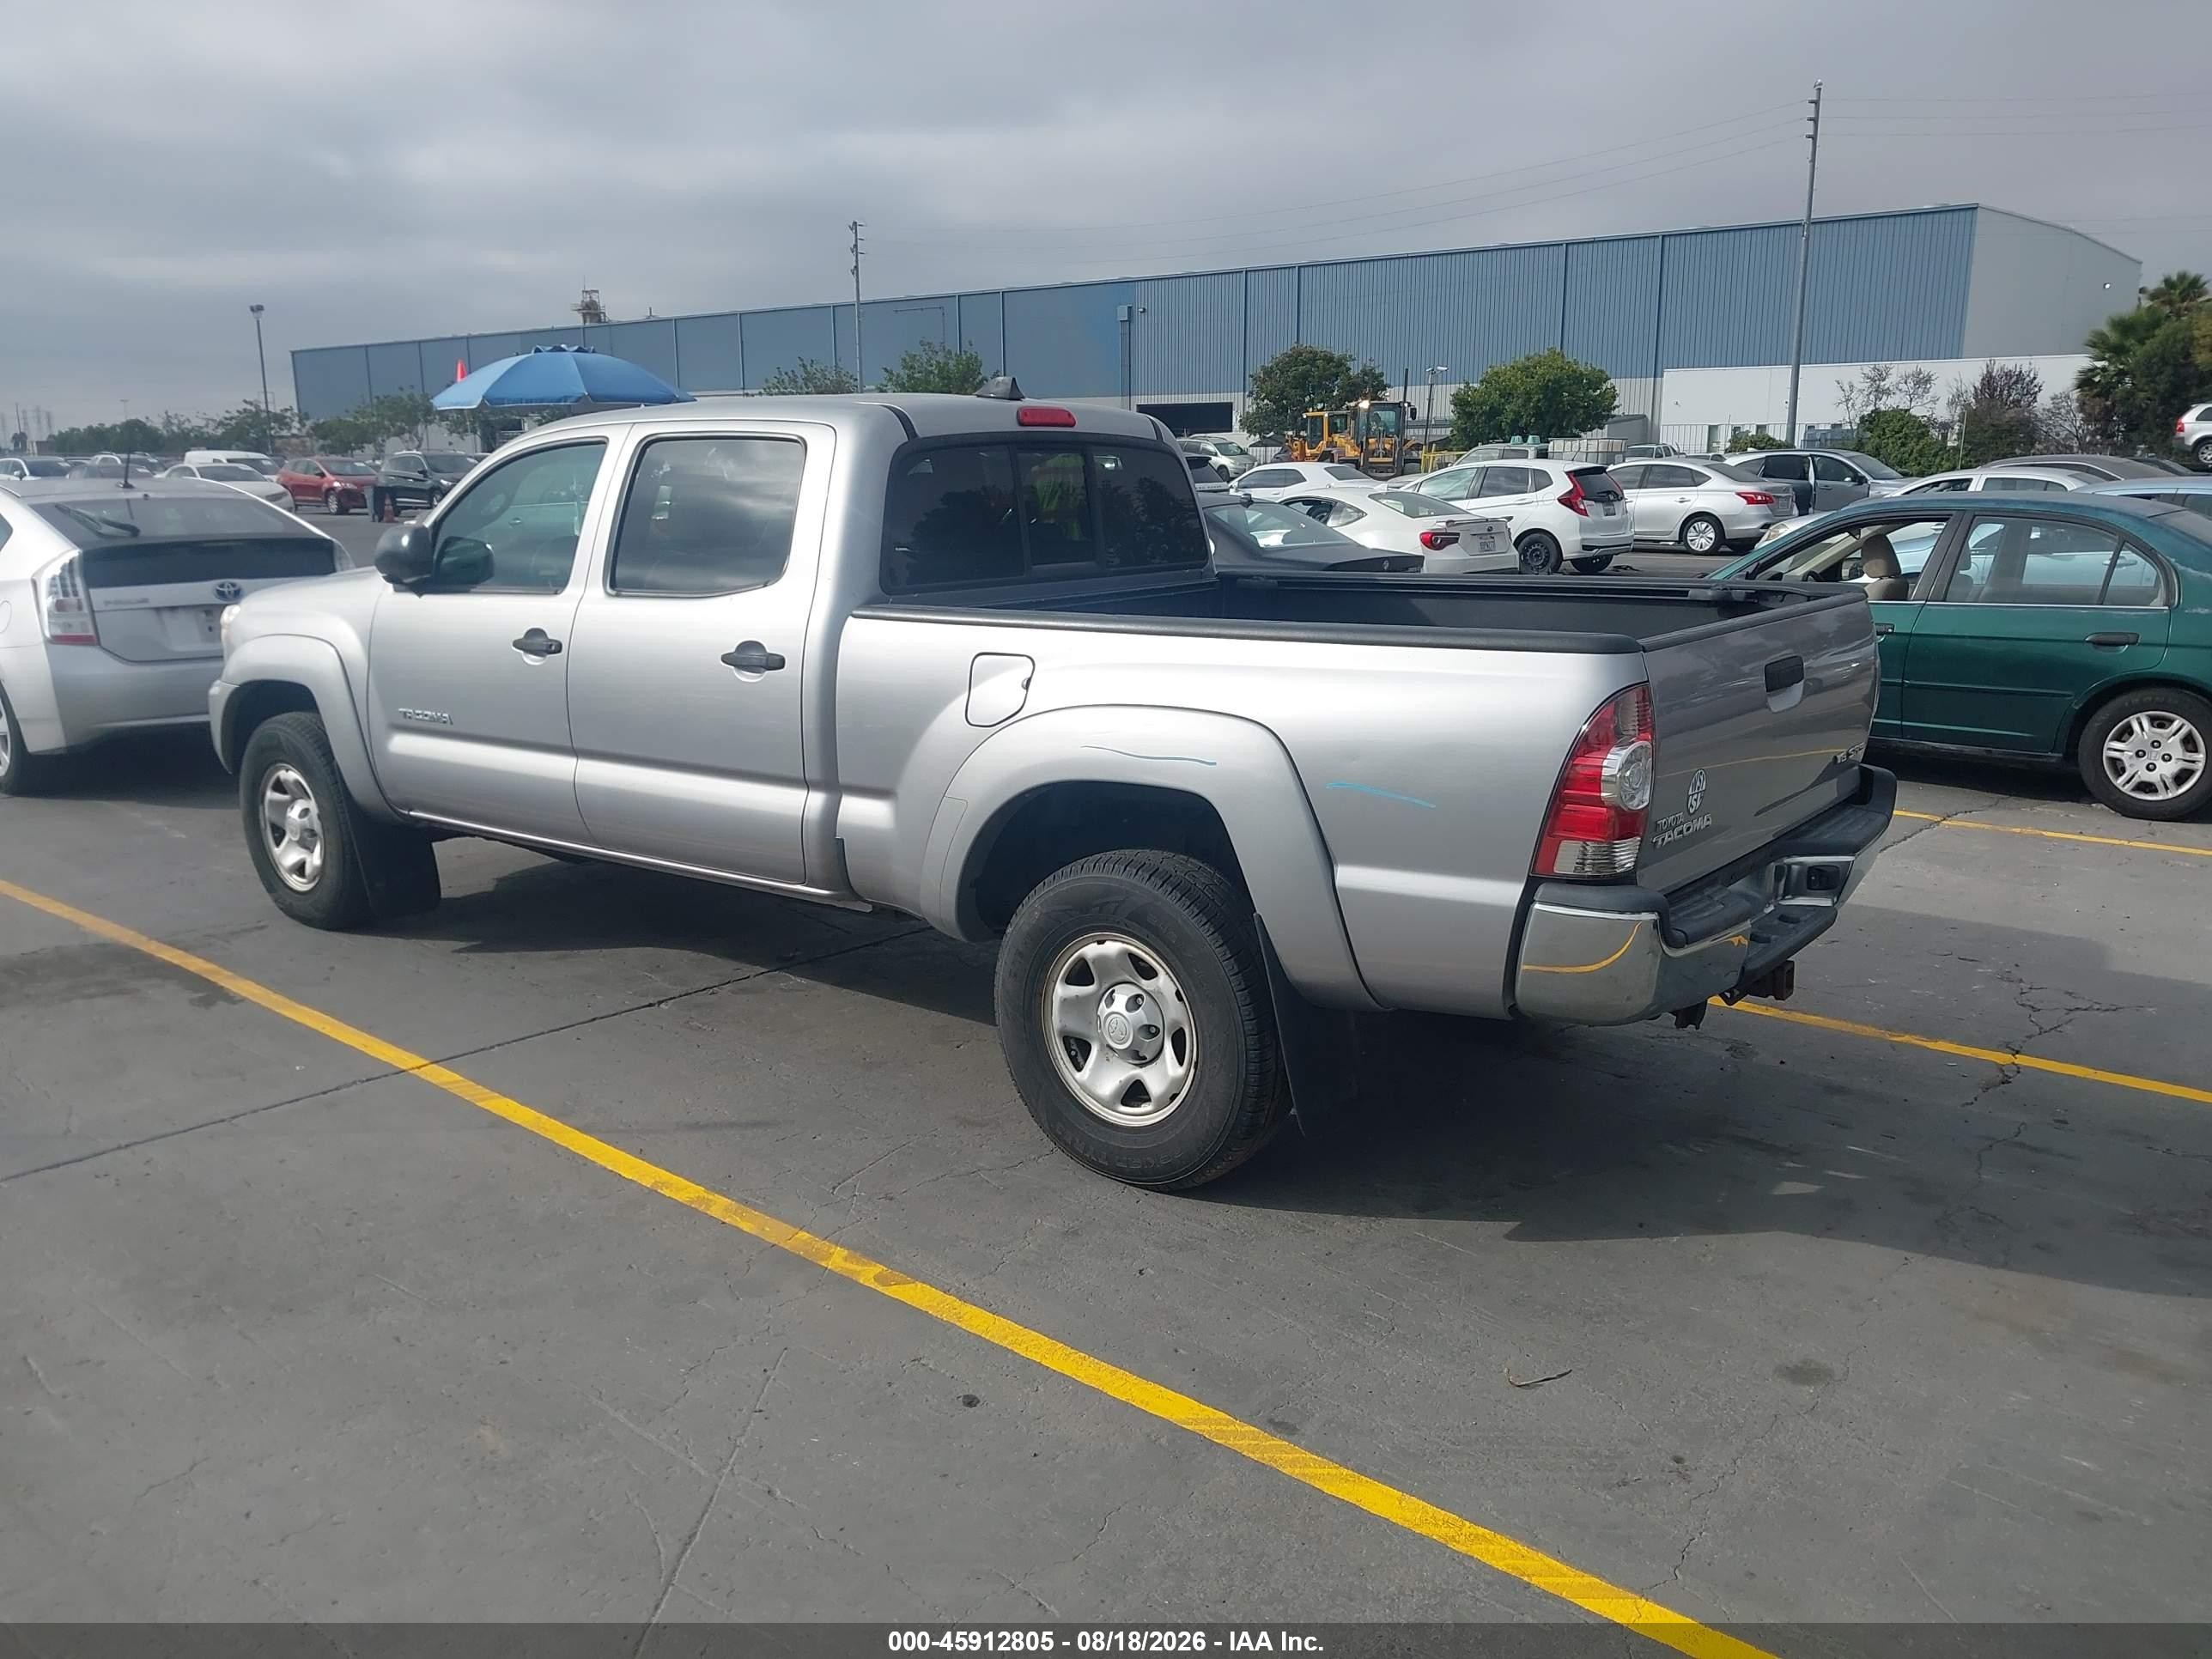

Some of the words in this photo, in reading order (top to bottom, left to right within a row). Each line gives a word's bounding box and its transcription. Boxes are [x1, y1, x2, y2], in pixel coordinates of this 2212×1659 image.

[398, 708, 453, 726] TACOMA
[1652, 813, 1712, 849] TACOMA
[1656, 811, 1684, 832] TOYOTA
